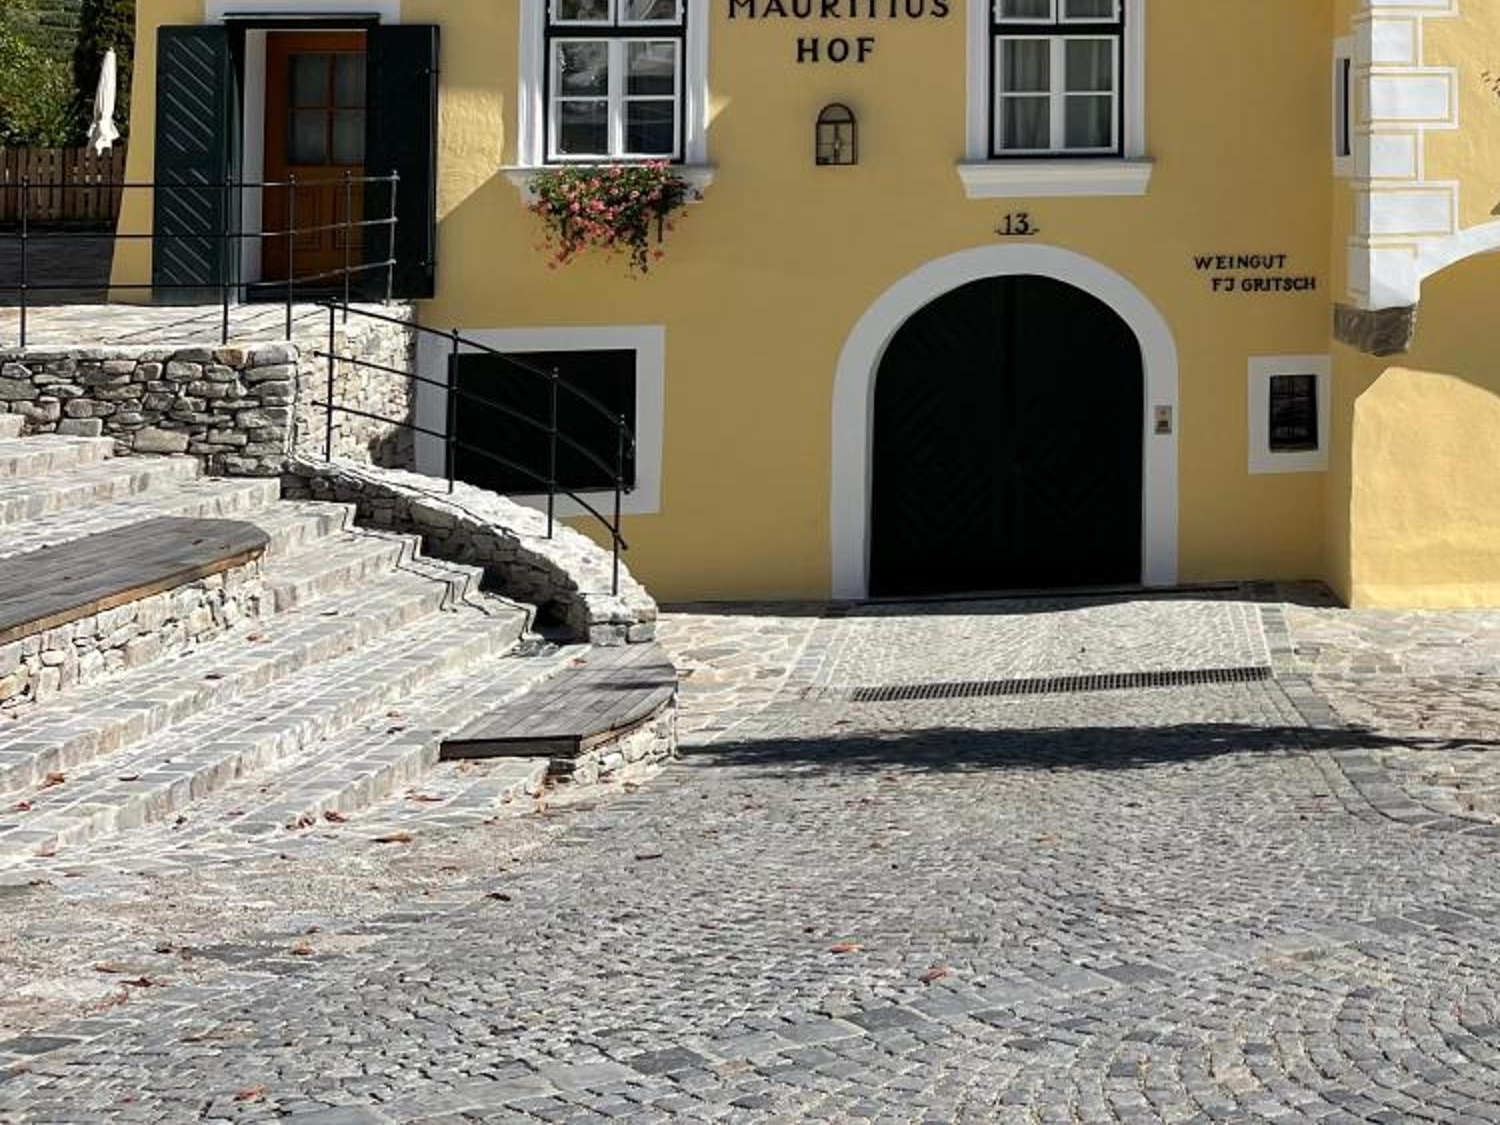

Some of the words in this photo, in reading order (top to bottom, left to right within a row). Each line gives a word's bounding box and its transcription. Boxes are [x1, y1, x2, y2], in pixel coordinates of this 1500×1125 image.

[797, 37, 875, 63] HOF
[1003, 212, 1029, 234] 13
[1194, 255, 1287, 269] WEINGUT
[1241, 277, 1316, 292] GRITSCH
